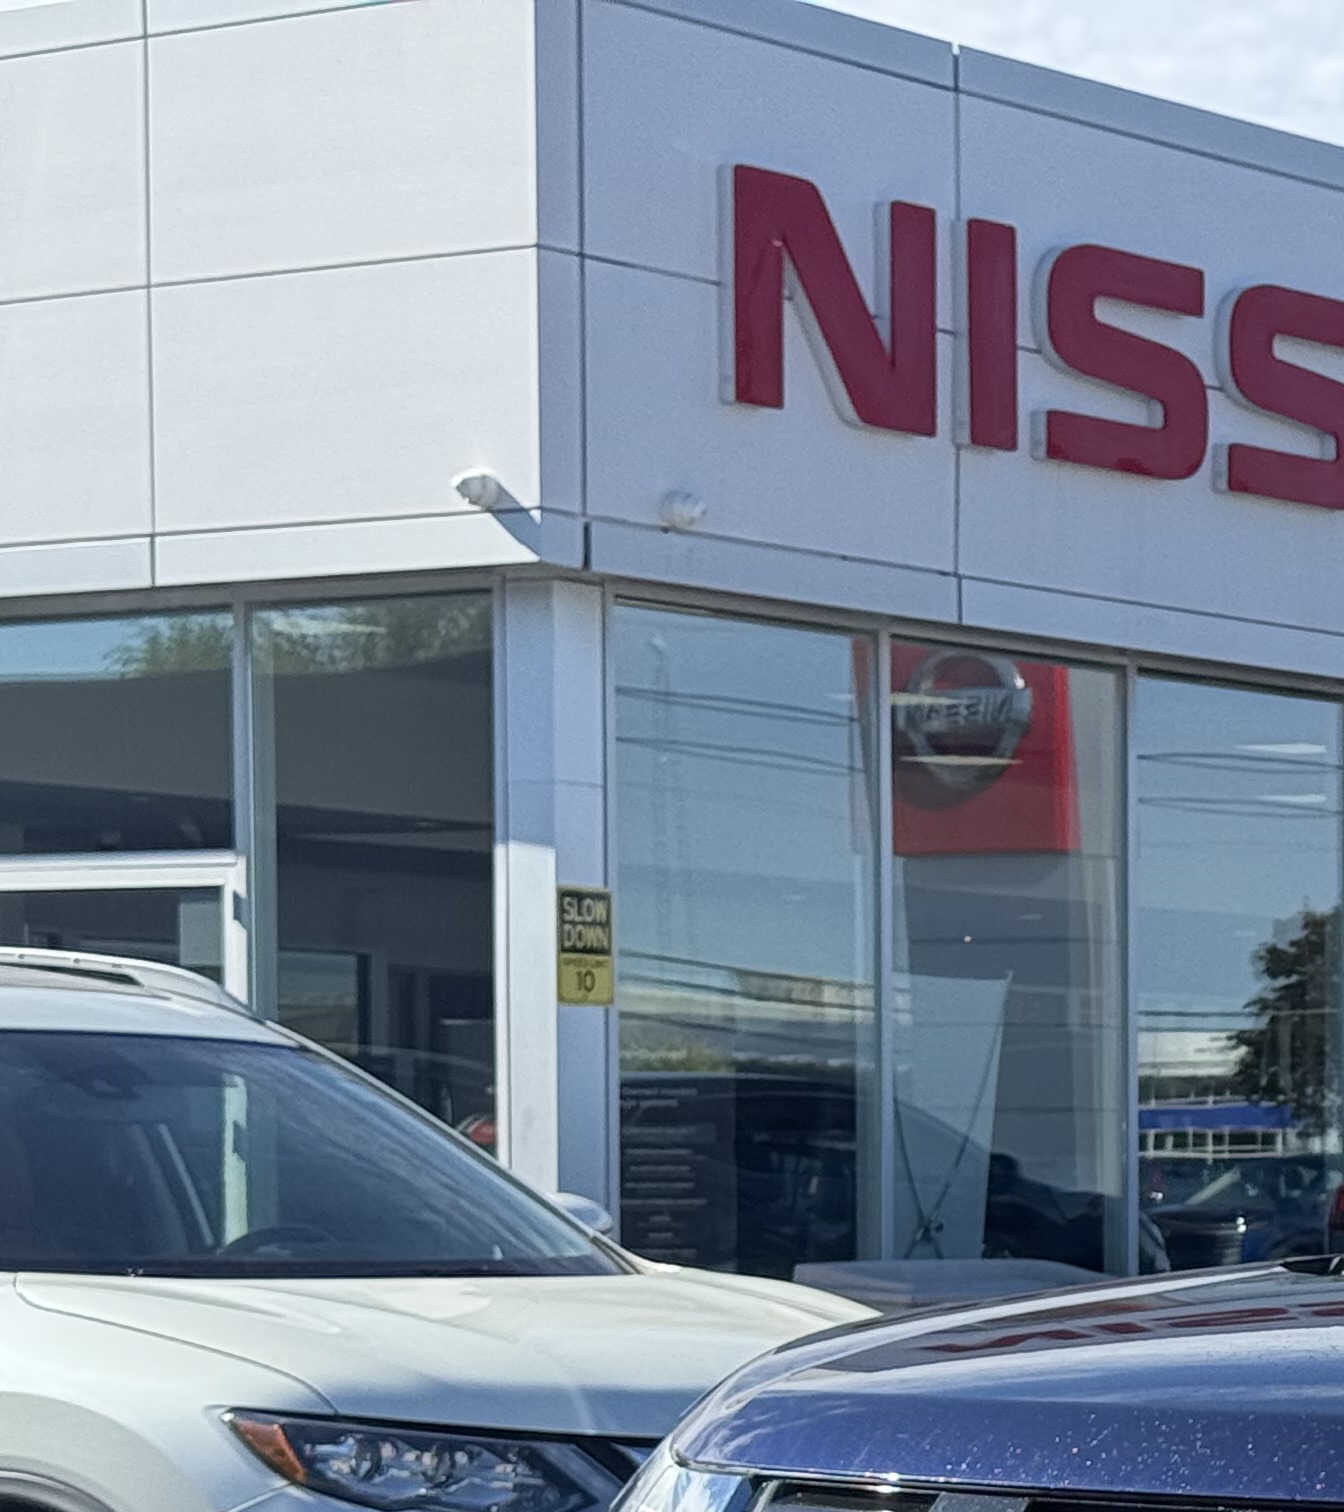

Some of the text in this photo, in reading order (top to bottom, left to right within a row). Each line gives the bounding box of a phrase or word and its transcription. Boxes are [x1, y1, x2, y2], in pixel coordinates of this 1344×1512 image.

[563, 896, 608, 923] SLOW
[563, 923, 609, 949] DOWN
[576, 969, 596, 993] 10
